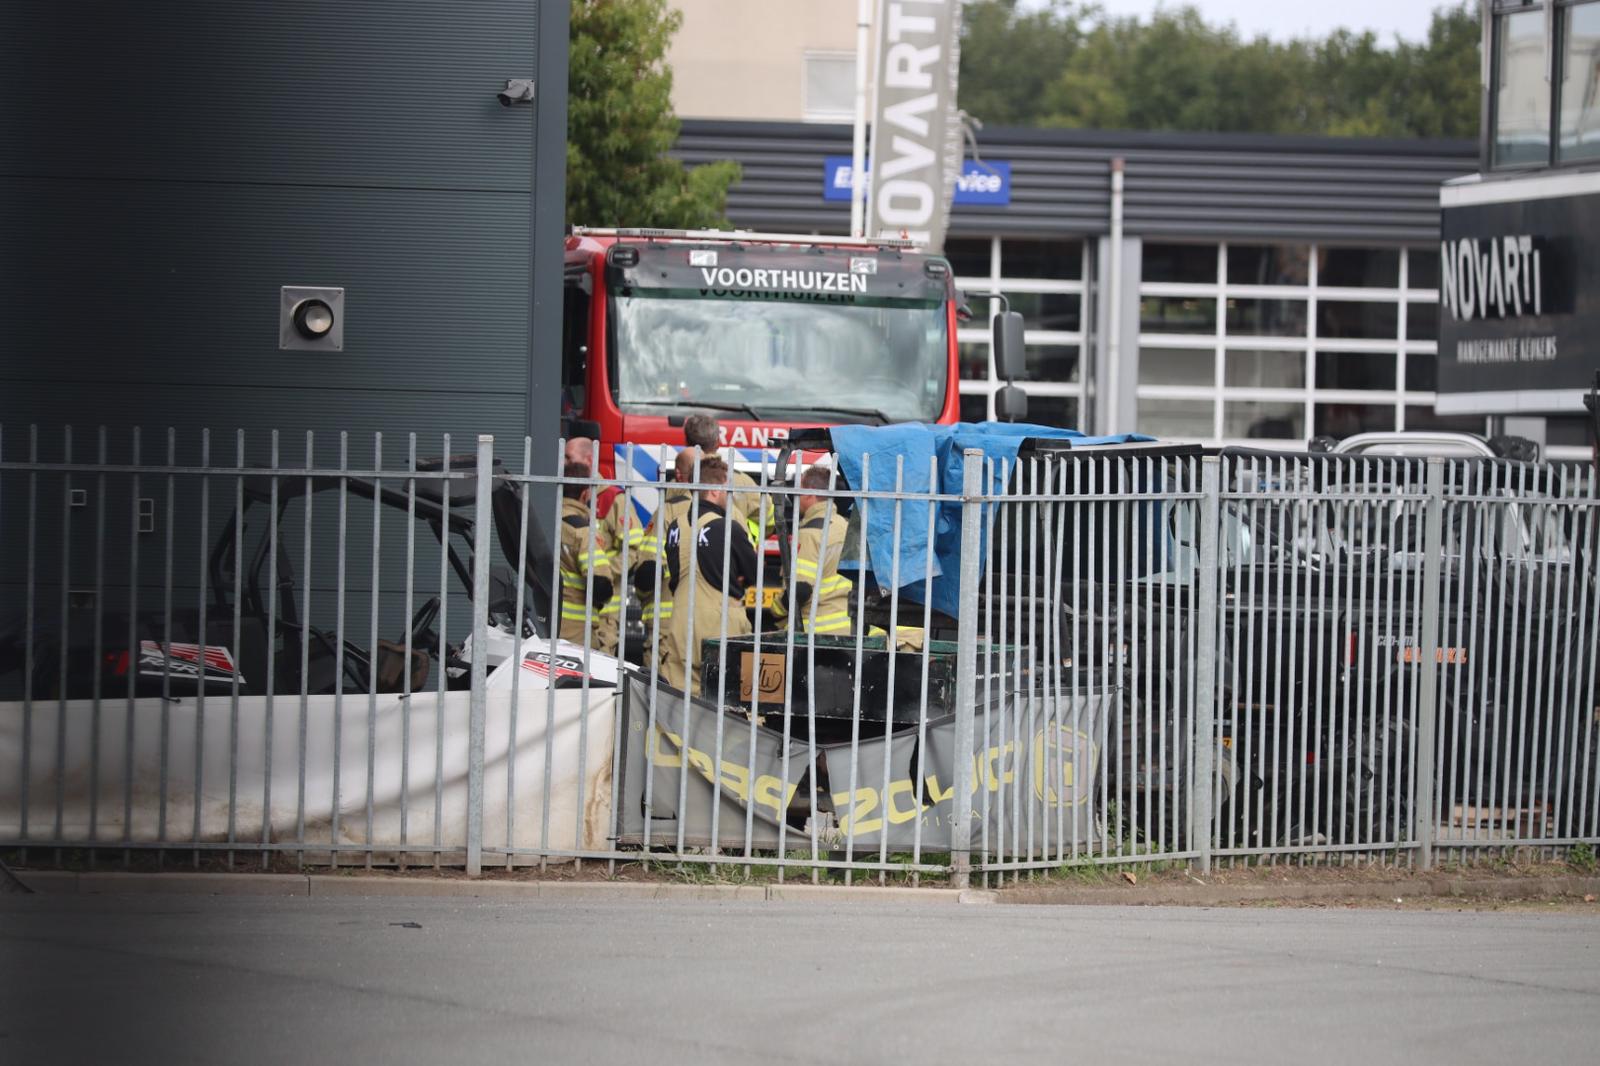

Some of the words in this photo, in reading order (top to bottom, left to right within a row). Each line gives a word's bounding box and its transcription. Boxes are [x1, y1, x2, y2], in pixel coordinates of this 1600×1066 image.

[876, 0, 943, 243] OVART
[701, 267, 867, 293] VOORTHUIZEN
[1441, 235, 1541, 321] NOVARTI
